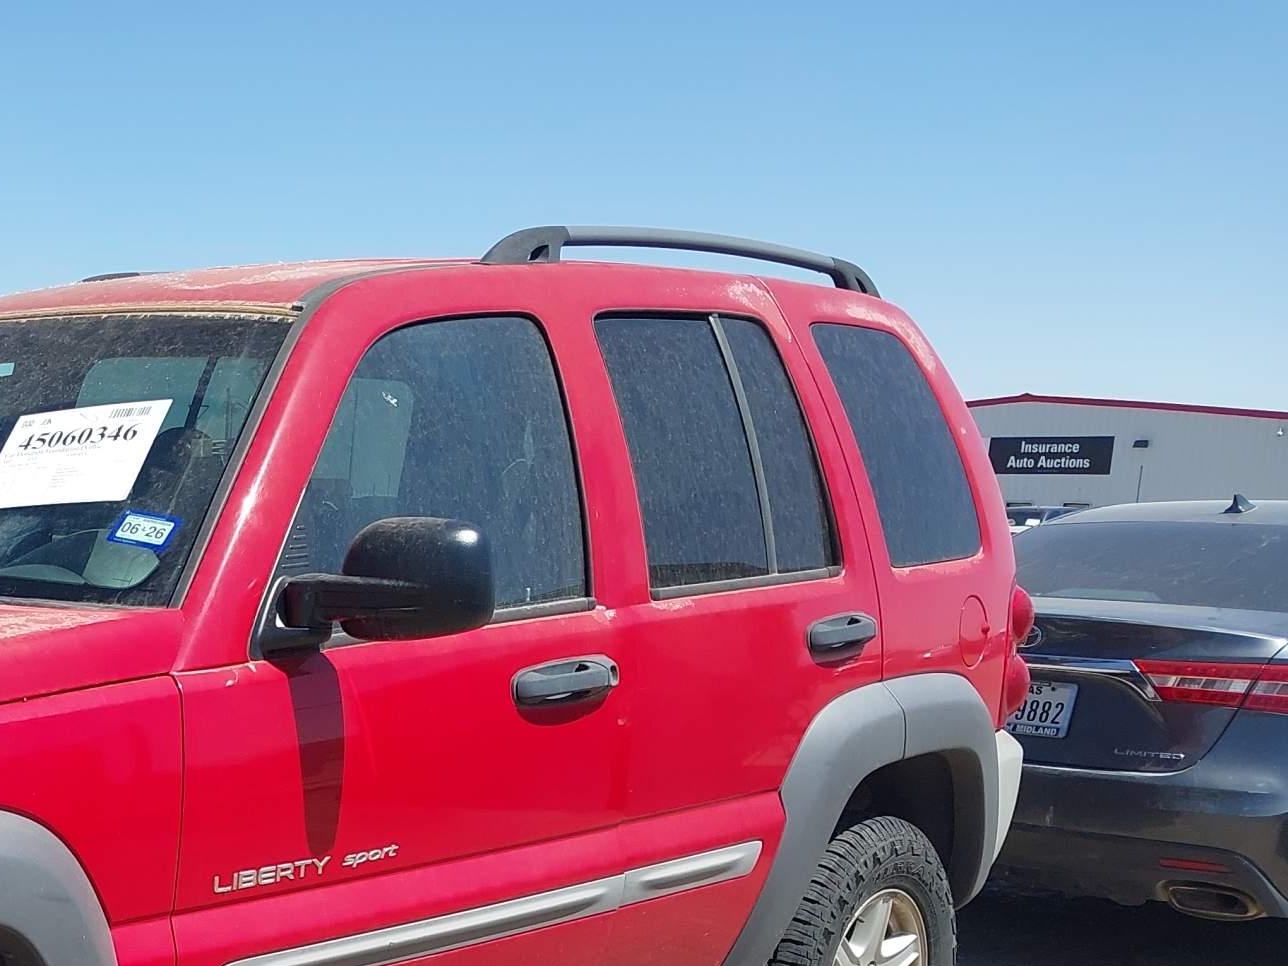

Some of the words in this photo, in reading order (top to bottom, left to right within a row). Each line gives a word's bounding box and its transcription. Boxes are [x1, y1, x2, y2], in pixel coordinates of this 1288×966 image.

[19, 422, 142, 450] 45060346
[1021, 441, 1080, 453] Insurance
[1007, 456, 1035, 468] Auto
[1038, 456, 1091, 468] Auctions
[121, 521, 141, 535] 06
[144, 526, 167, 539] 26
[1015, 724, 1057, 736] MIDLAND
[1113, 748, 1185, 760] LIMITED
[213, 855, 331, 894] LIBERTY
[342, 844, 400, 868] sport
